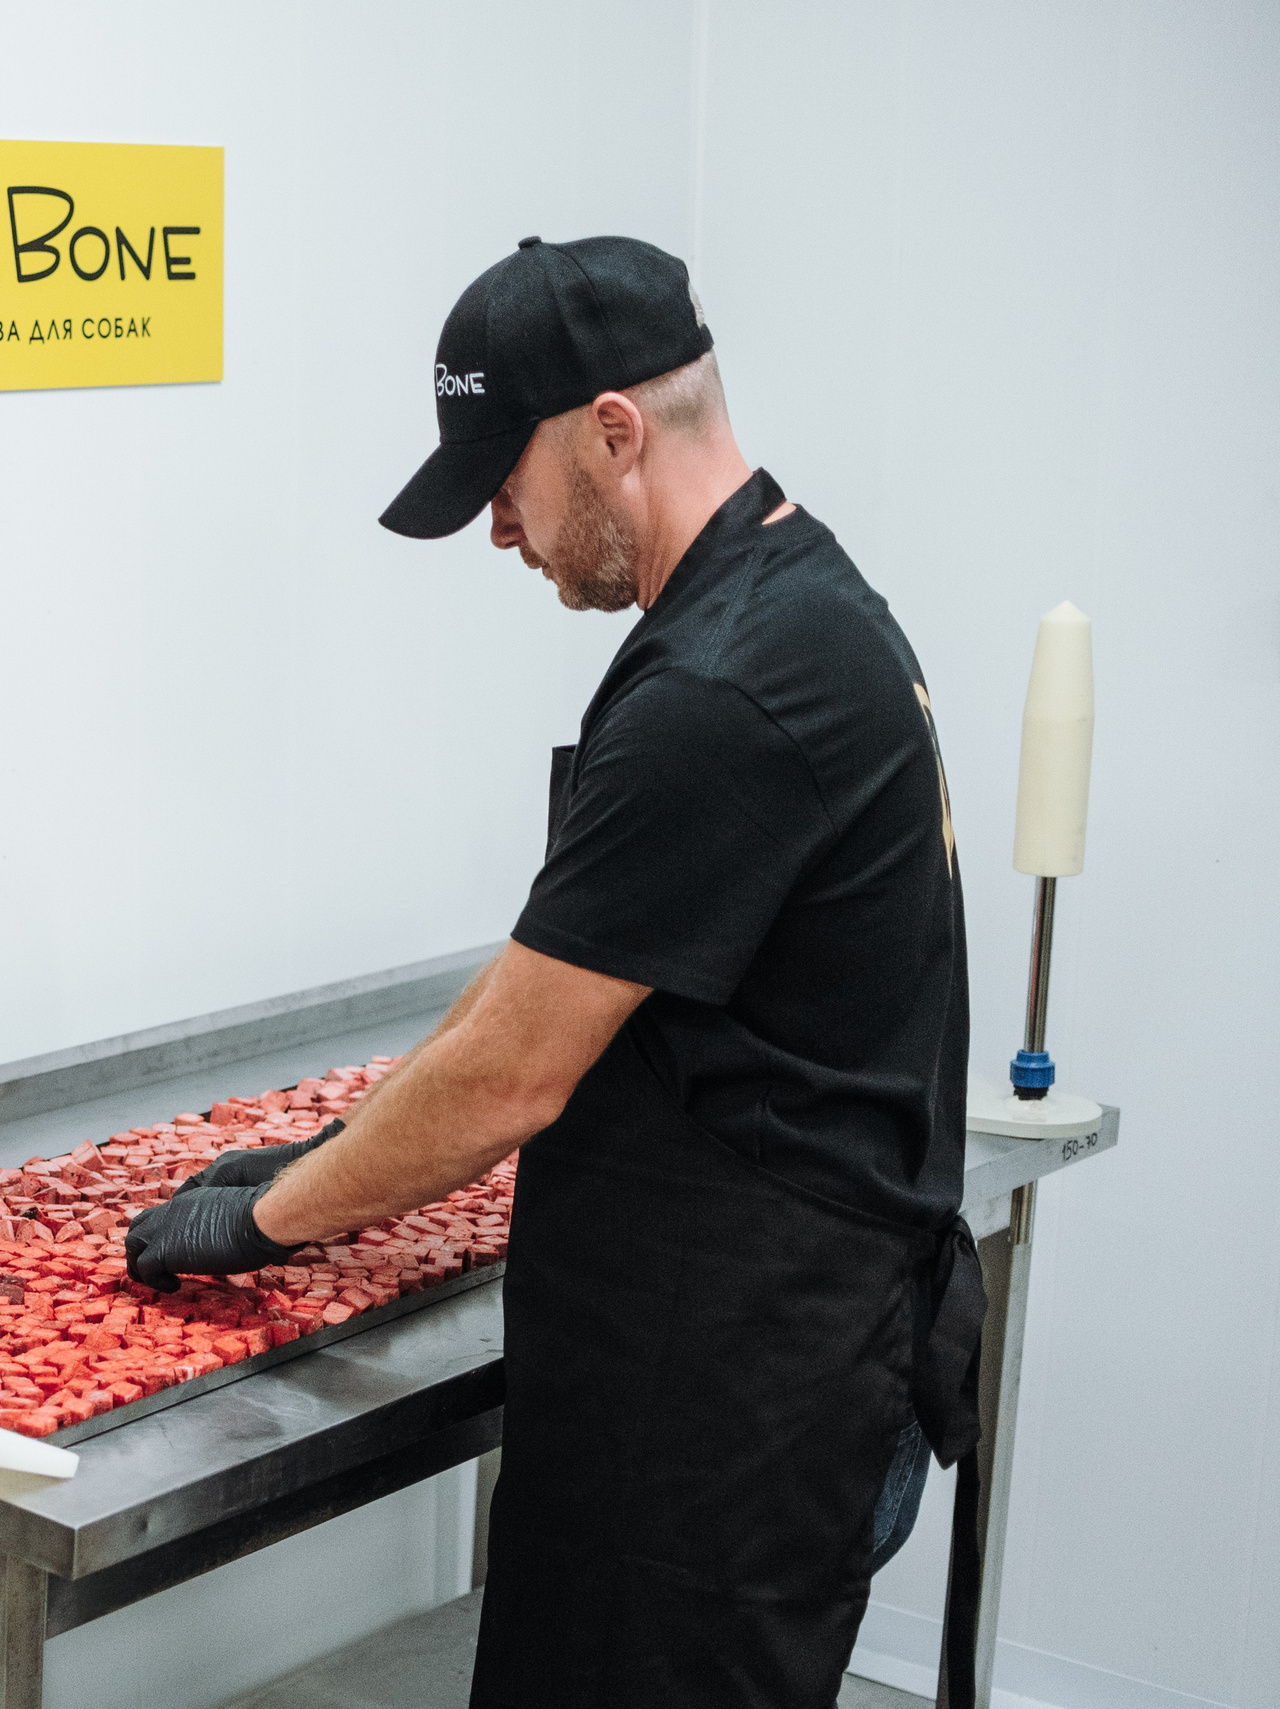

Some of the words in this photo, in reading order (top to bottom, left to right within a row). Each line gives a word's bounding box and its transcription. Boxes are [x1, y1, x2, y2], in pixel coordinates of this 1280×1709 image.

[29, 319, 73, 345] ДЛЯ
[81, 316, 152, 340] СОБАК
[435, 363, 486, 397] BONE
